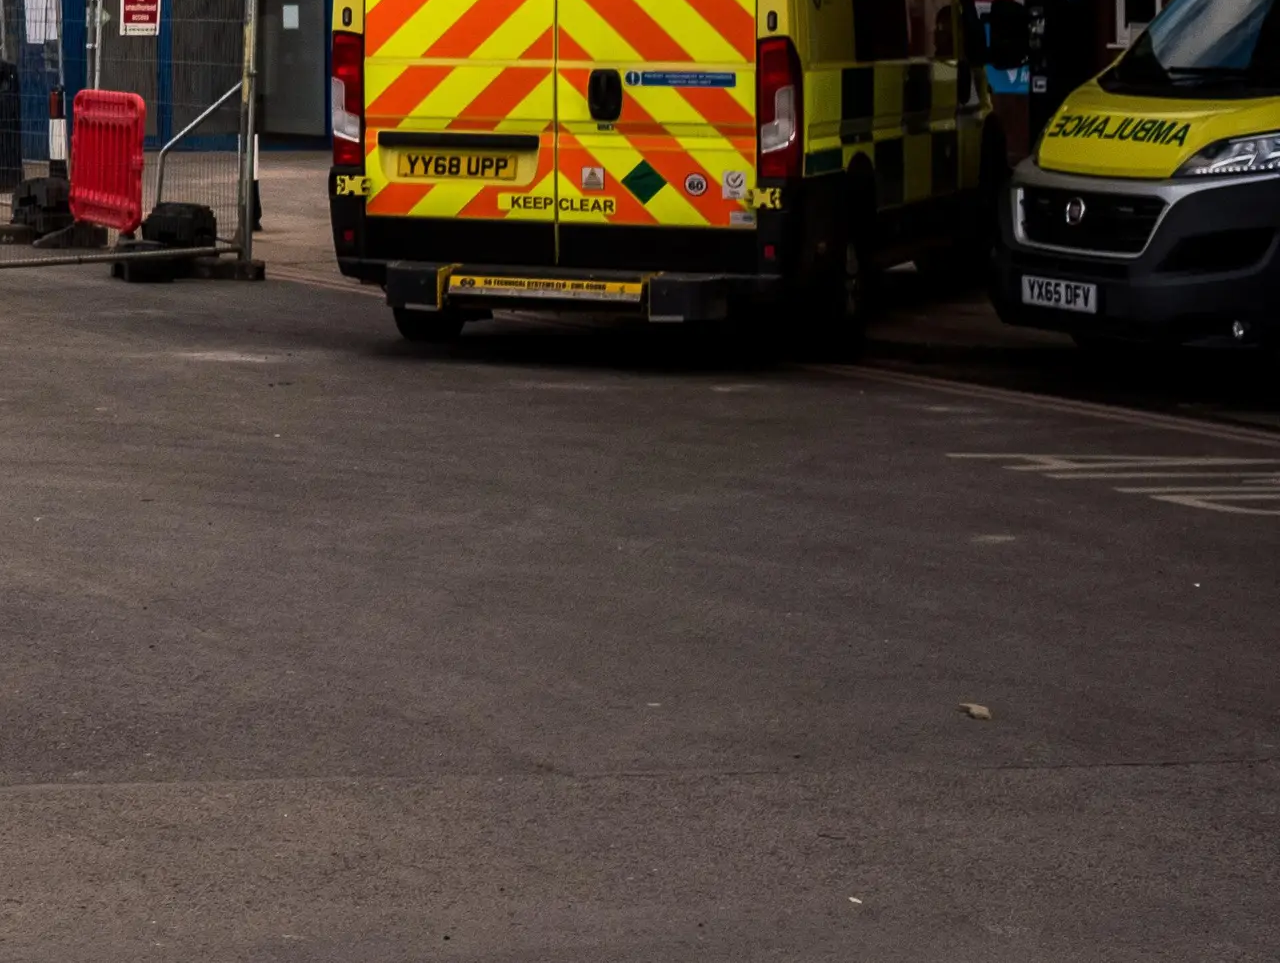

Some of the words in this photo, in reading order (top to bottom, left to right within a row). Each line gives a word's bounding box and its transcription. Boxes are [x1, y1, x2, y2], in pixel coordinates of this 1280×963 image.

[406, 154, 461, 177] YY68
[466, 156, 508, 178] UPP
[687, 181, 703, 191] 60
[511, 196, 553, 210] KEEP
[559, 198, 614, 213] CLEAR
[1028, 278, 1061, 302] YX65
[1065, 283, 1091, 308] DFV
